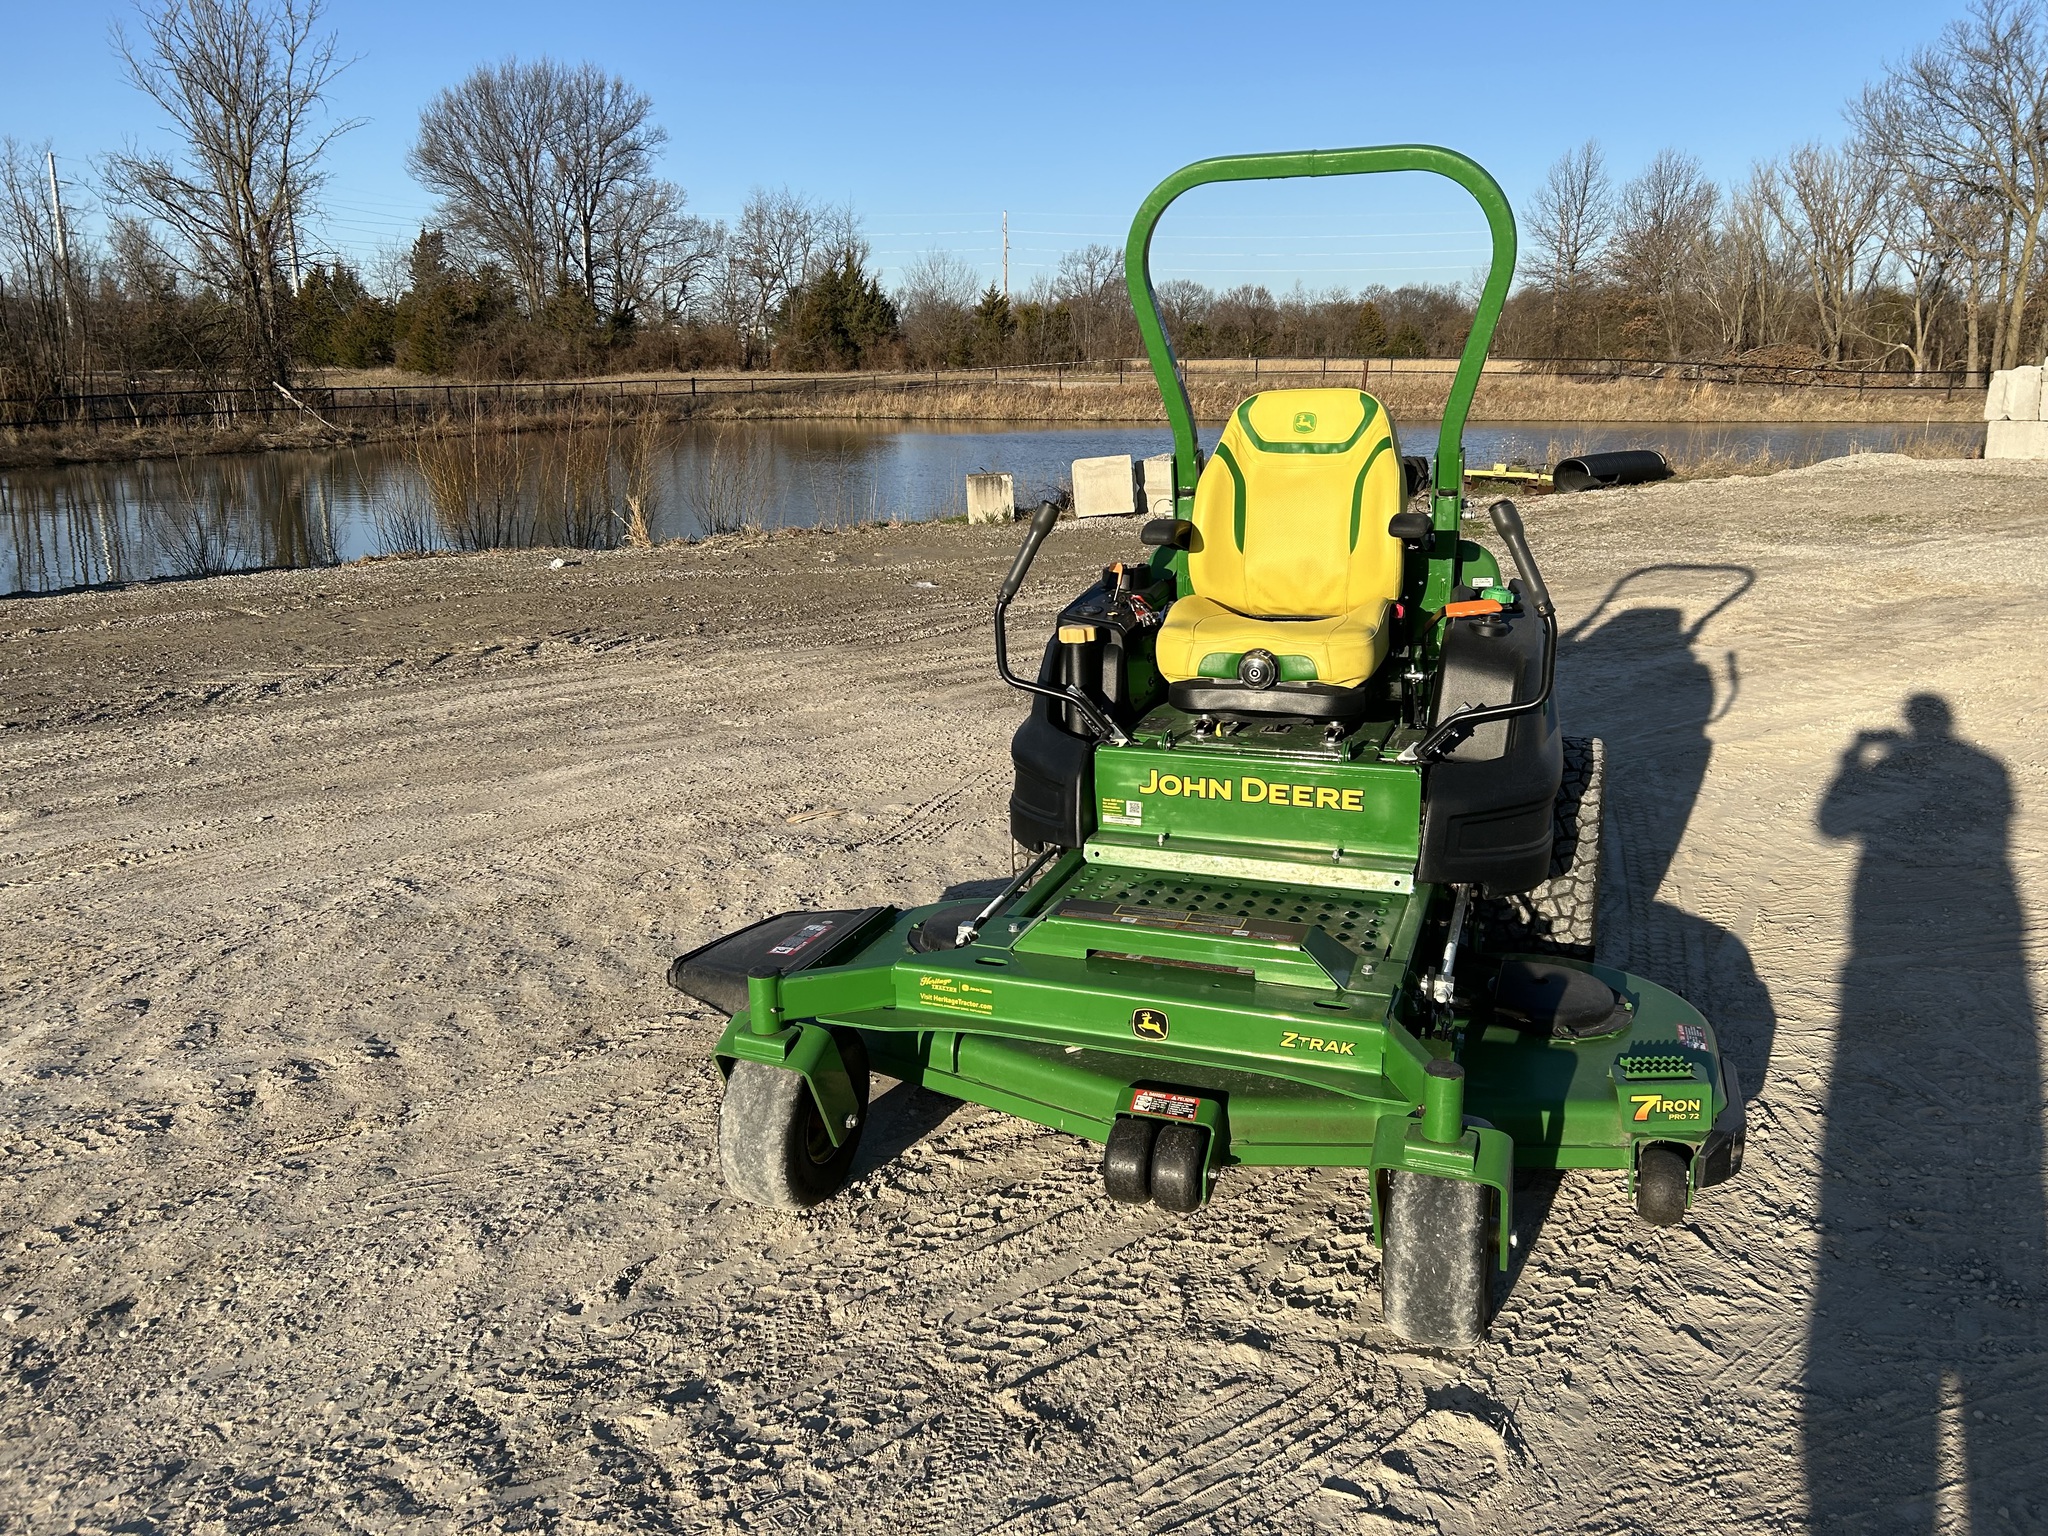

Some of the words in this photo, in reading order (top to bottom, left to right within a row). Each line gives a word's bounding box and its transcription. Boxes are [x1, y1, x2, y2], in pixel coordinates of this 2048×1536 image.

[1139, 769, 1232, 801] JOHN
[1240, 776, 1364, 812] DEERE
[933, 995, 992, 1010] HeritageTractor.com
